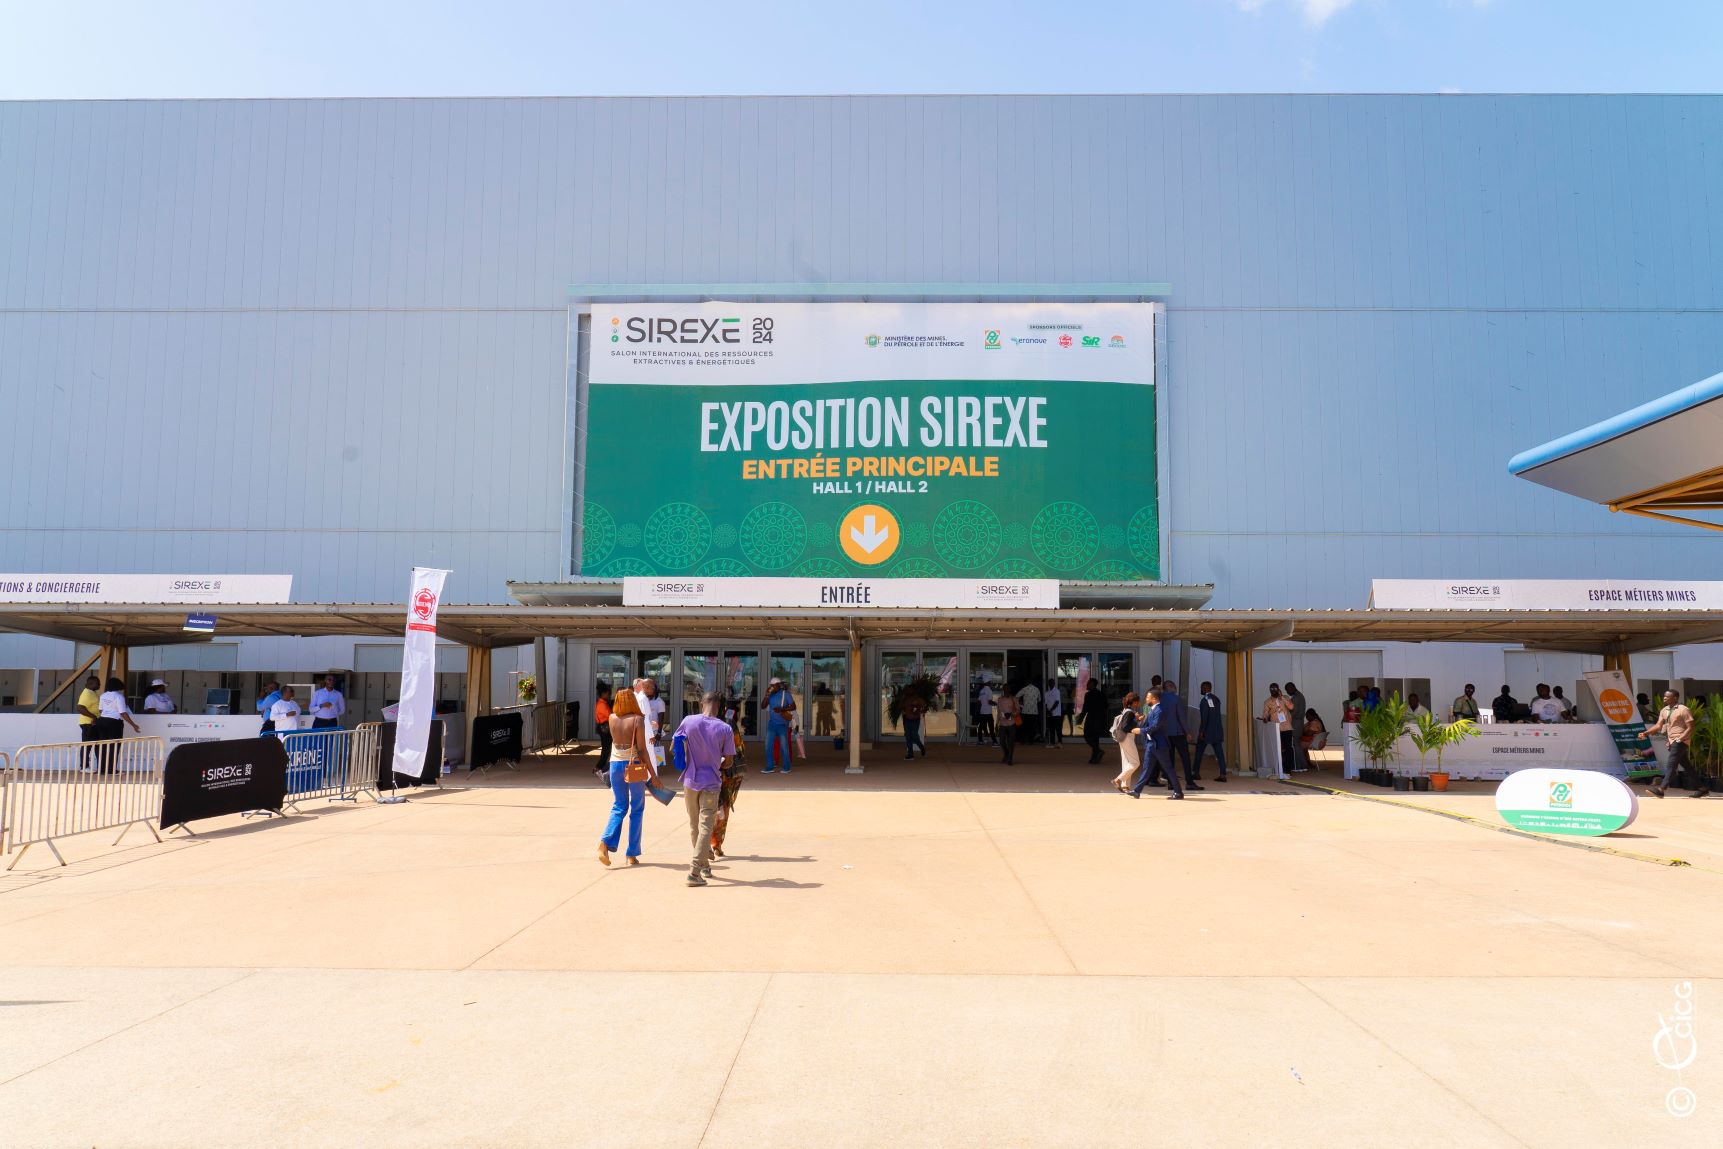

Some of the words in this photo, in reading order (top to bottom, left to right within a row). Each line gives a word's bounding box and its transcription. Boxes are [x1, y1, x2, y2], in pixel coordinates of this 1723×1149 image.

[626, 317, 741, 344] SIREXE
[700, 396, 909, 452] EXPOSITION
[919, 396, 1048, 448] SIREXE
[742, 453, 840, 480] ENTRÉE
[846, 456, 999, 478] PRINCIPALE
[813, 481, 853, 494] HALL
[855, 481, 862, 494] 1
[874, 481, 917, 493] HALL
[917, 480, 928, 493] 2
[26, 582, 33, 593] &
[35, 582, 101, 594] CONCIERGERIE
[174, 581, 211, 590] SIREXE
[656, 583, 694, 593] SIREXE
[821, 582, 871, 603] ENTRÉE
[981, 585, 1019, 595] SIREXE
[1451, 586, 1490, 595] SIREXE
[1588, 589, 1622, 601] ESPACE
[1624, 587, 1664, 601] MÉTIERS
[1666, 590, 1697, 602] MINES
